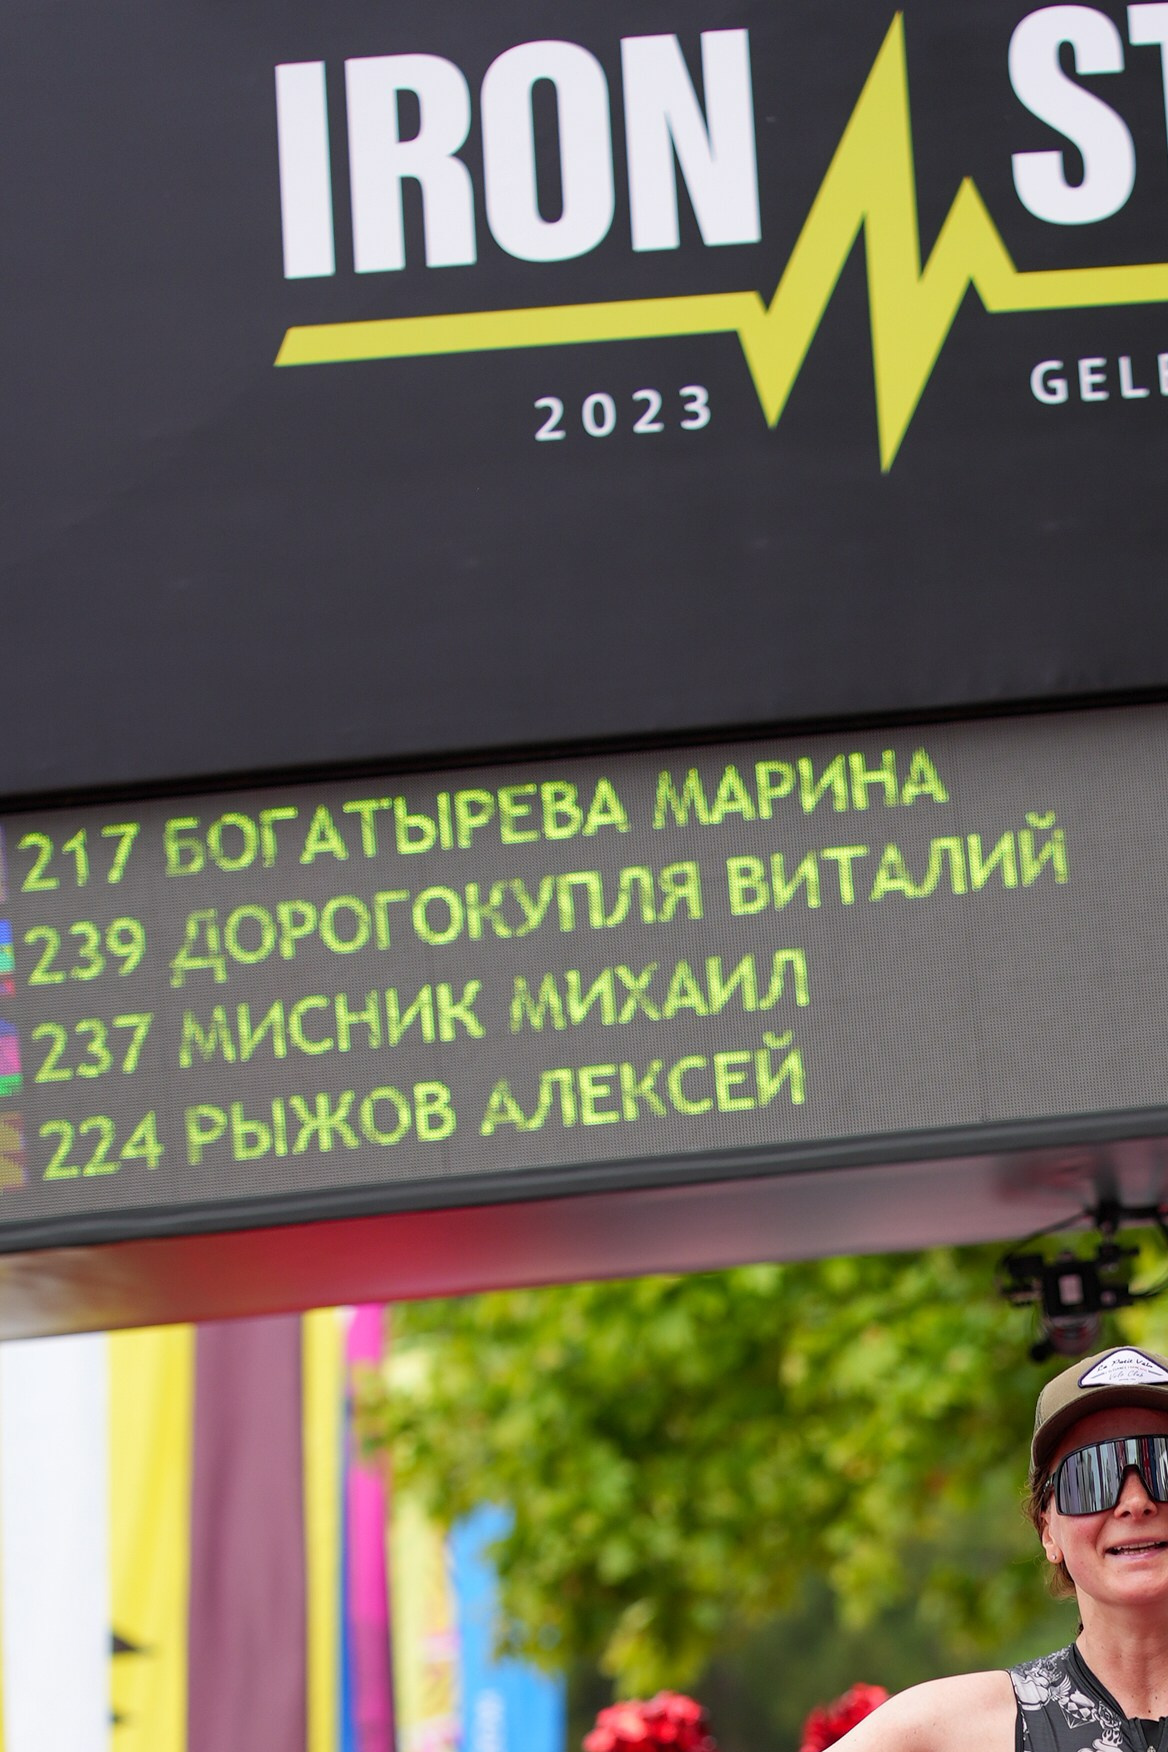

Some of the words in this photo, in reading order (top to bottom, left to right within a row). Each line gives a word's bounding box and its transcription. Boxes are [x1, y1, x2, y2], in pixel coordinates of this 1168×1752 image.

[274, 28, 762, 279] IRON
[534, 385, 711, 441] 2023
[17, 822, 141, 892] 217
[164, 777, 629, 876] БОГАТЫРЕВА
[653, 749, 948, 829] МАРИНА
[24, 916, 146, 985] 239
[170, 860, 704, 988] ДОРОГОКУПЛЯ
[727, 811, 1068, 915] ВИТАЛИЙ
[31, 1012, 153, 1083] 237
[179, 979, 485, 1068] МИСНИК
[510, 948, 809, 1034] МИХАИЛ
[39, 1111, 164, 1180] 224
[185, 1080, 457, 1166] РЫЖОВ
[480, 1031, 805, 1136] АЛЕКСЕЙ
